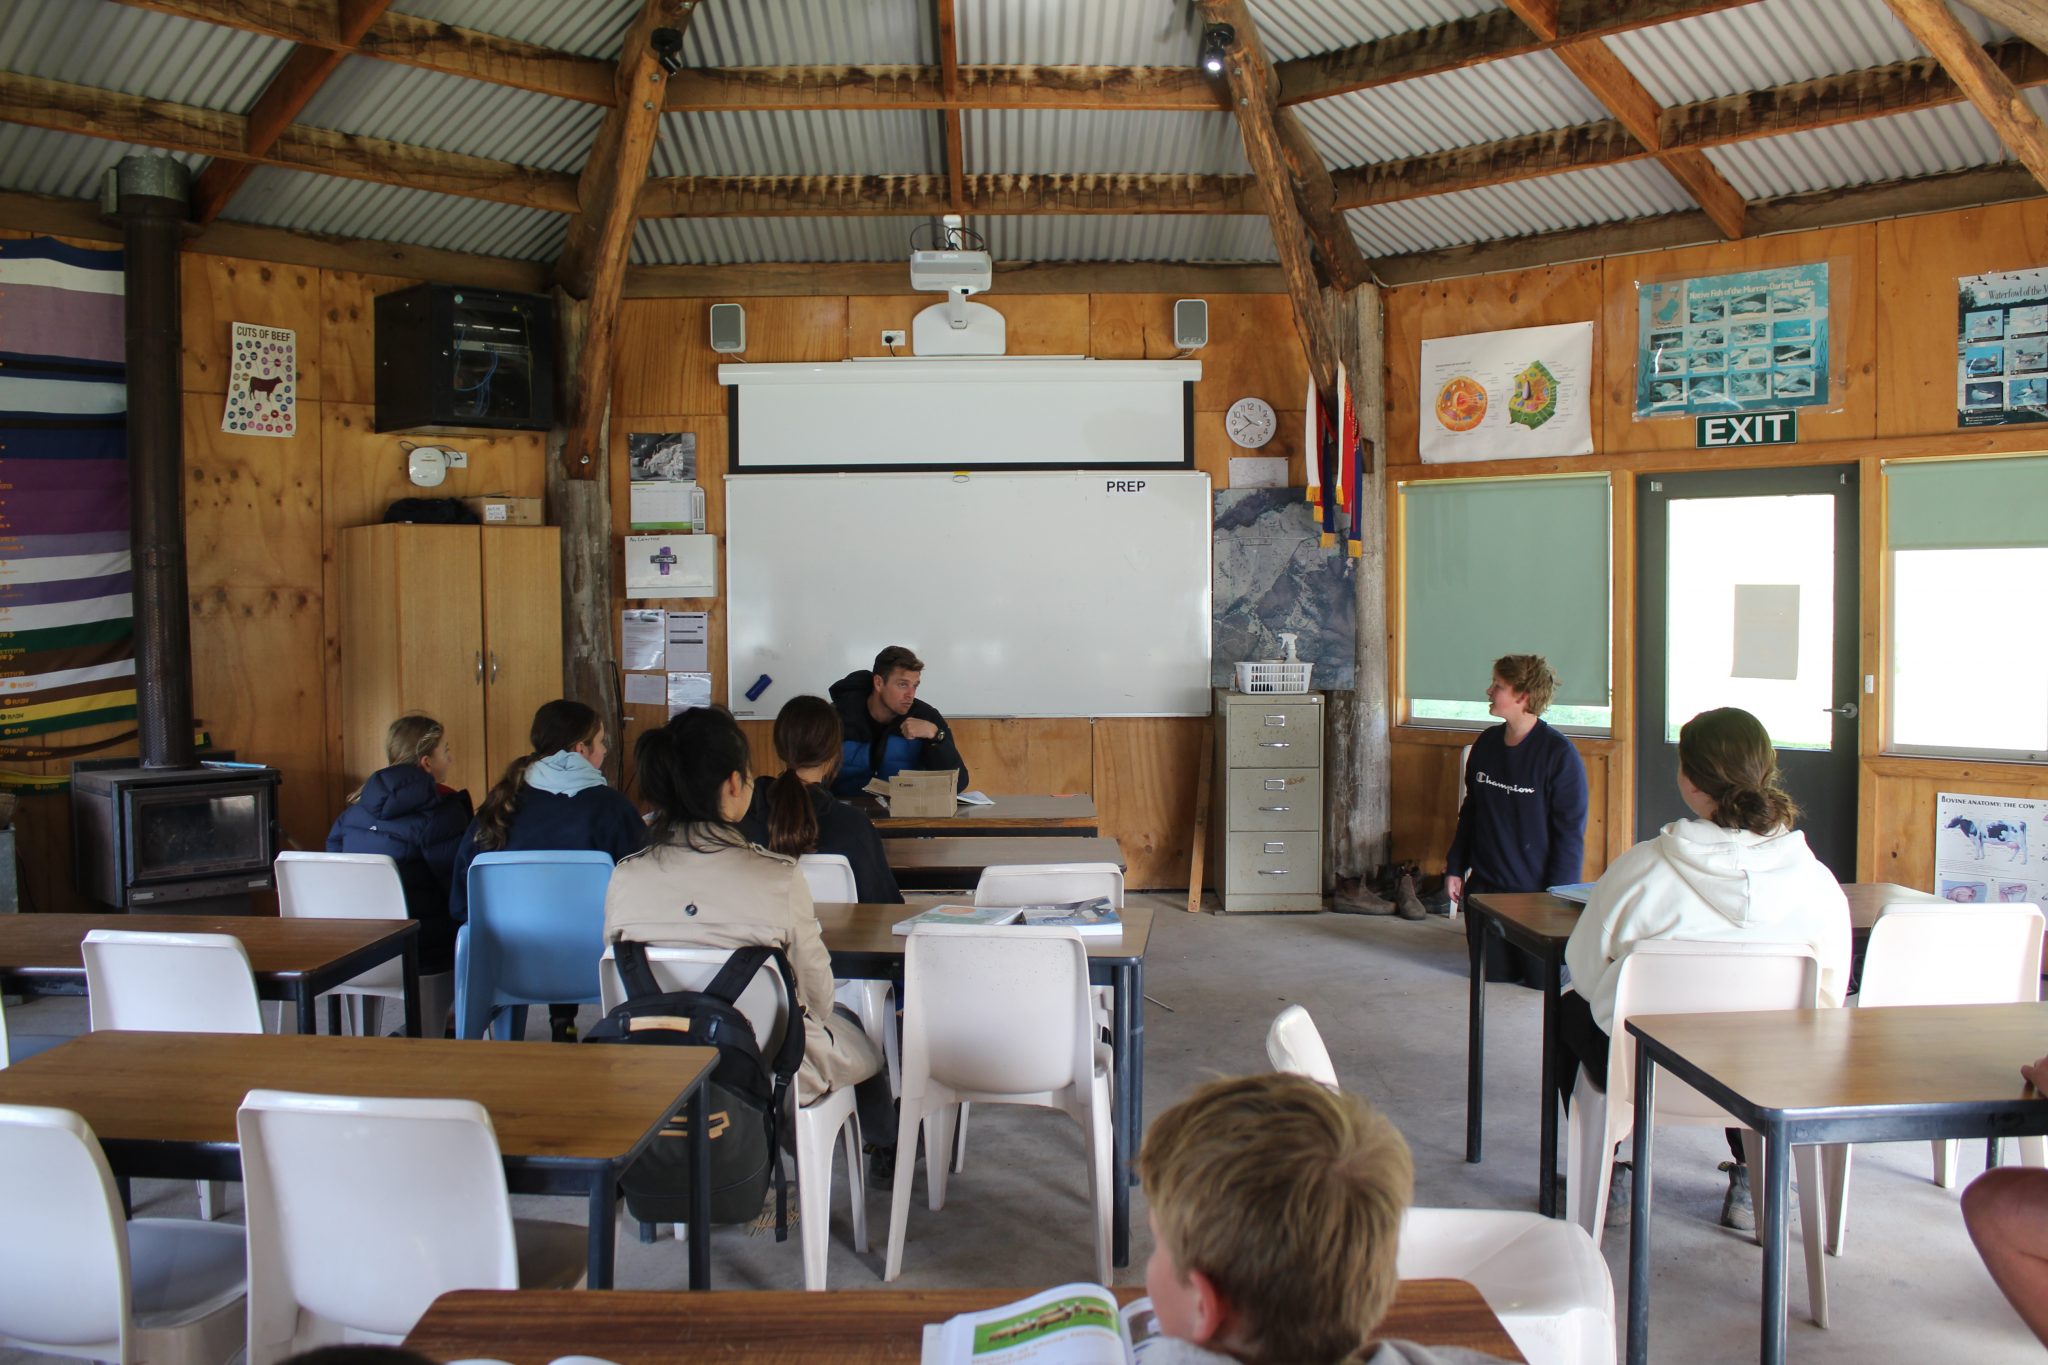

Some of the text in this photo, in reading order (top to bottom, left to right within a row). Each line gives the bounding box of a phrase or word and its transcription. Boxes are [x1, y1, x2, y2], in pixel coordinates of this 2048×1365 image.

[1989, 288, 2022, 299] Waterfowl
[2032, 285, 2042, 296] the
[236, 326, 291, 342] CUTS OF BEEF
[1705, 414, 1790, 446] EXIT
[1106, 480, 1146, 493] PREP
[1475, 771, 1536, 795] Champion
[1941, 796, 1966, 804] BOVINE
